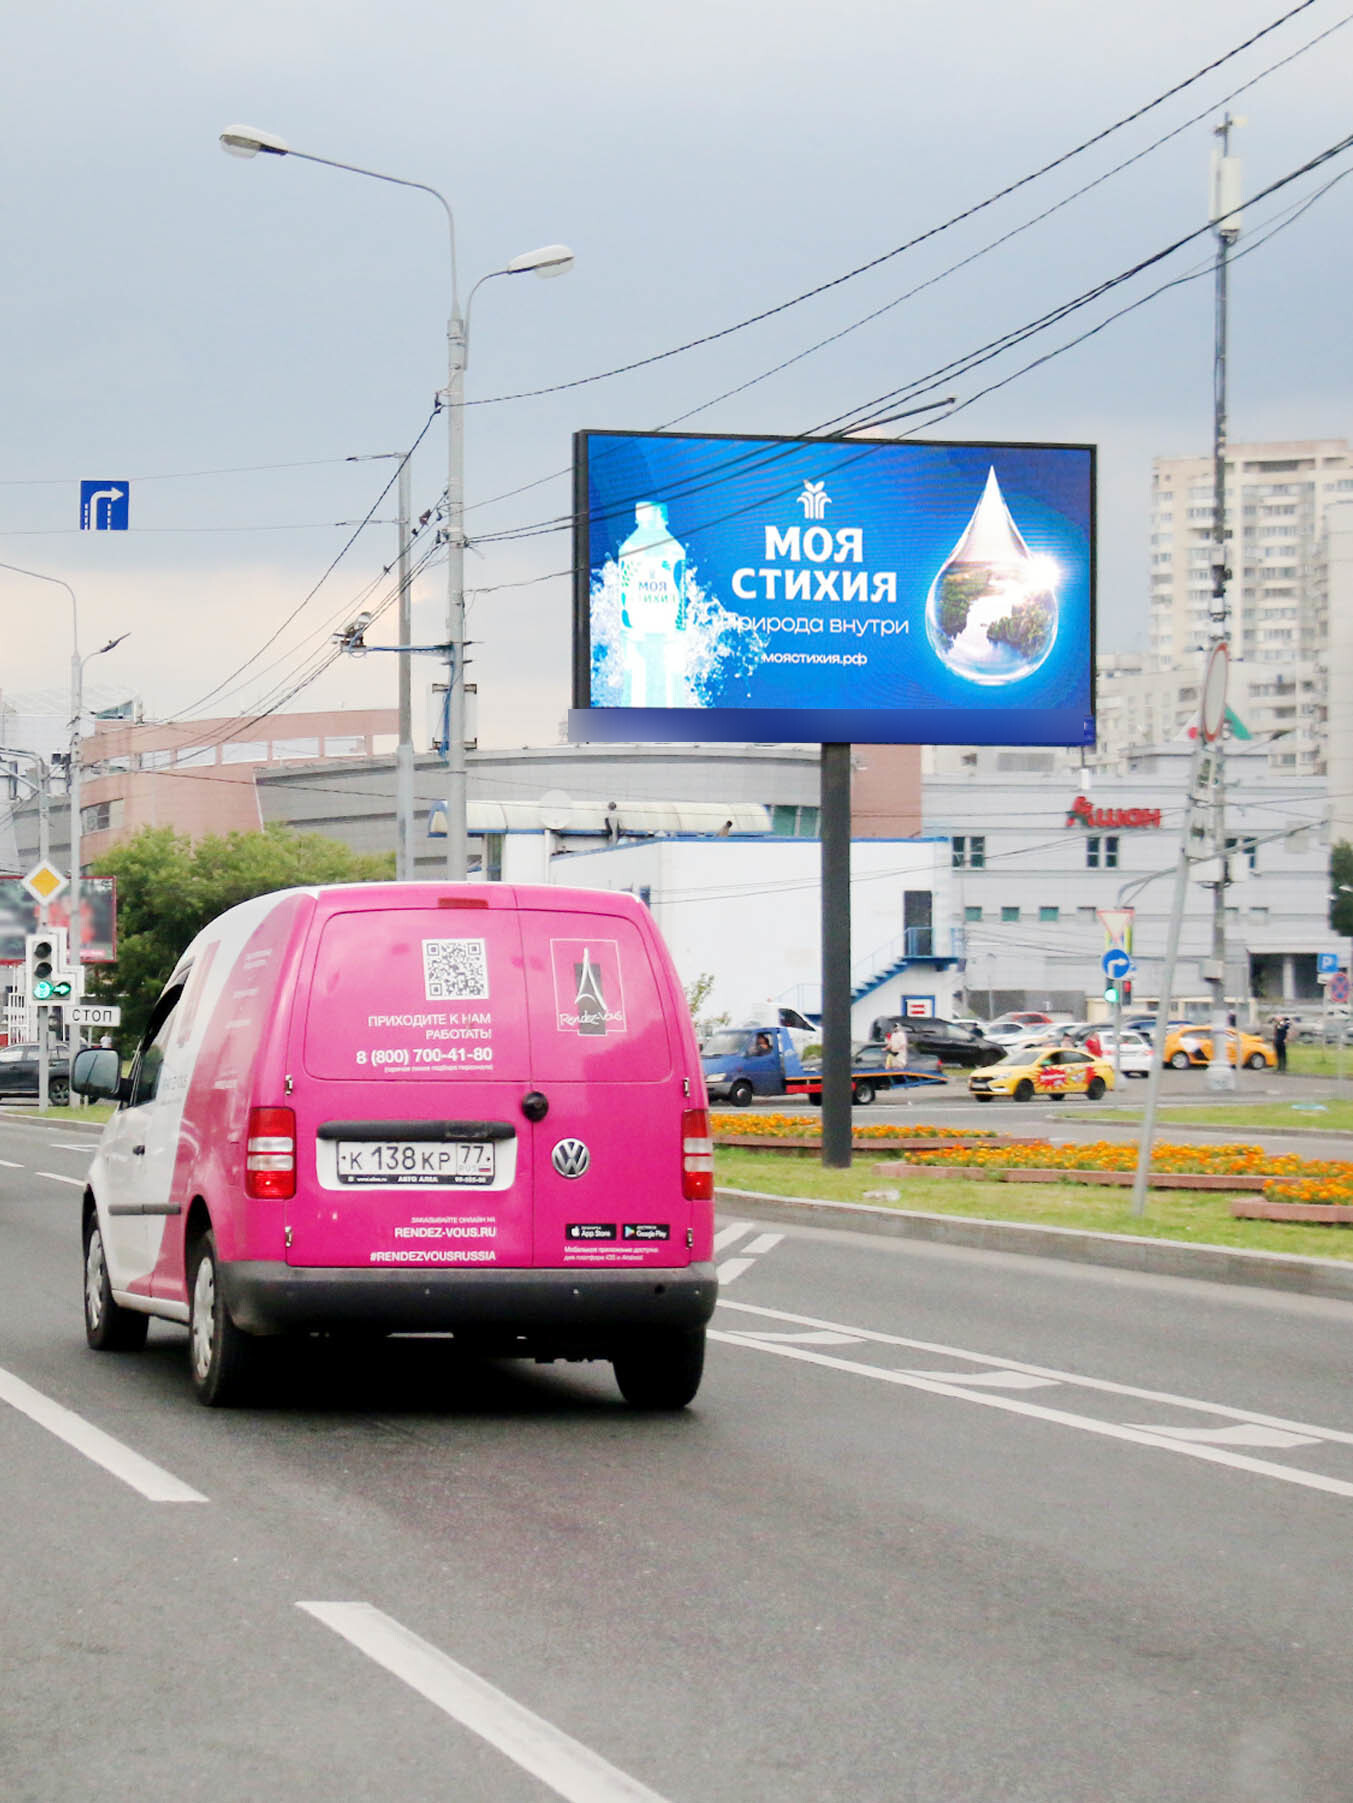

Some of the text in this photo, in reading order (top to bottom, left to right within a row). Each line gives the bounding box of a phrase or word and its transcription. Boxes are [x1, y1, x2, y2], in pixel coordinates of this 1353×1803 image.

[765, 525, 863, 563] МОЯ
[638, 581, 667, 592] МОЯ
[731, 568, 897, 603] СТИХИЯ
[830, 619, 909, 637] внутри
[762, 653, 868, 666] моястихия.рф
[72, 1009, 112, 1022] СТОП
[368, 1013, 492, 1028] ПРИХОДИТЕ К НАМ
[356, 1047, 493, 1066] 8 (800) 700-41-80
[394, 1227, 497, 1238] RENDEZ-VOUS.RU
[369, 1250, 497, 1262] #RENDEZVOUSRUSSIA
